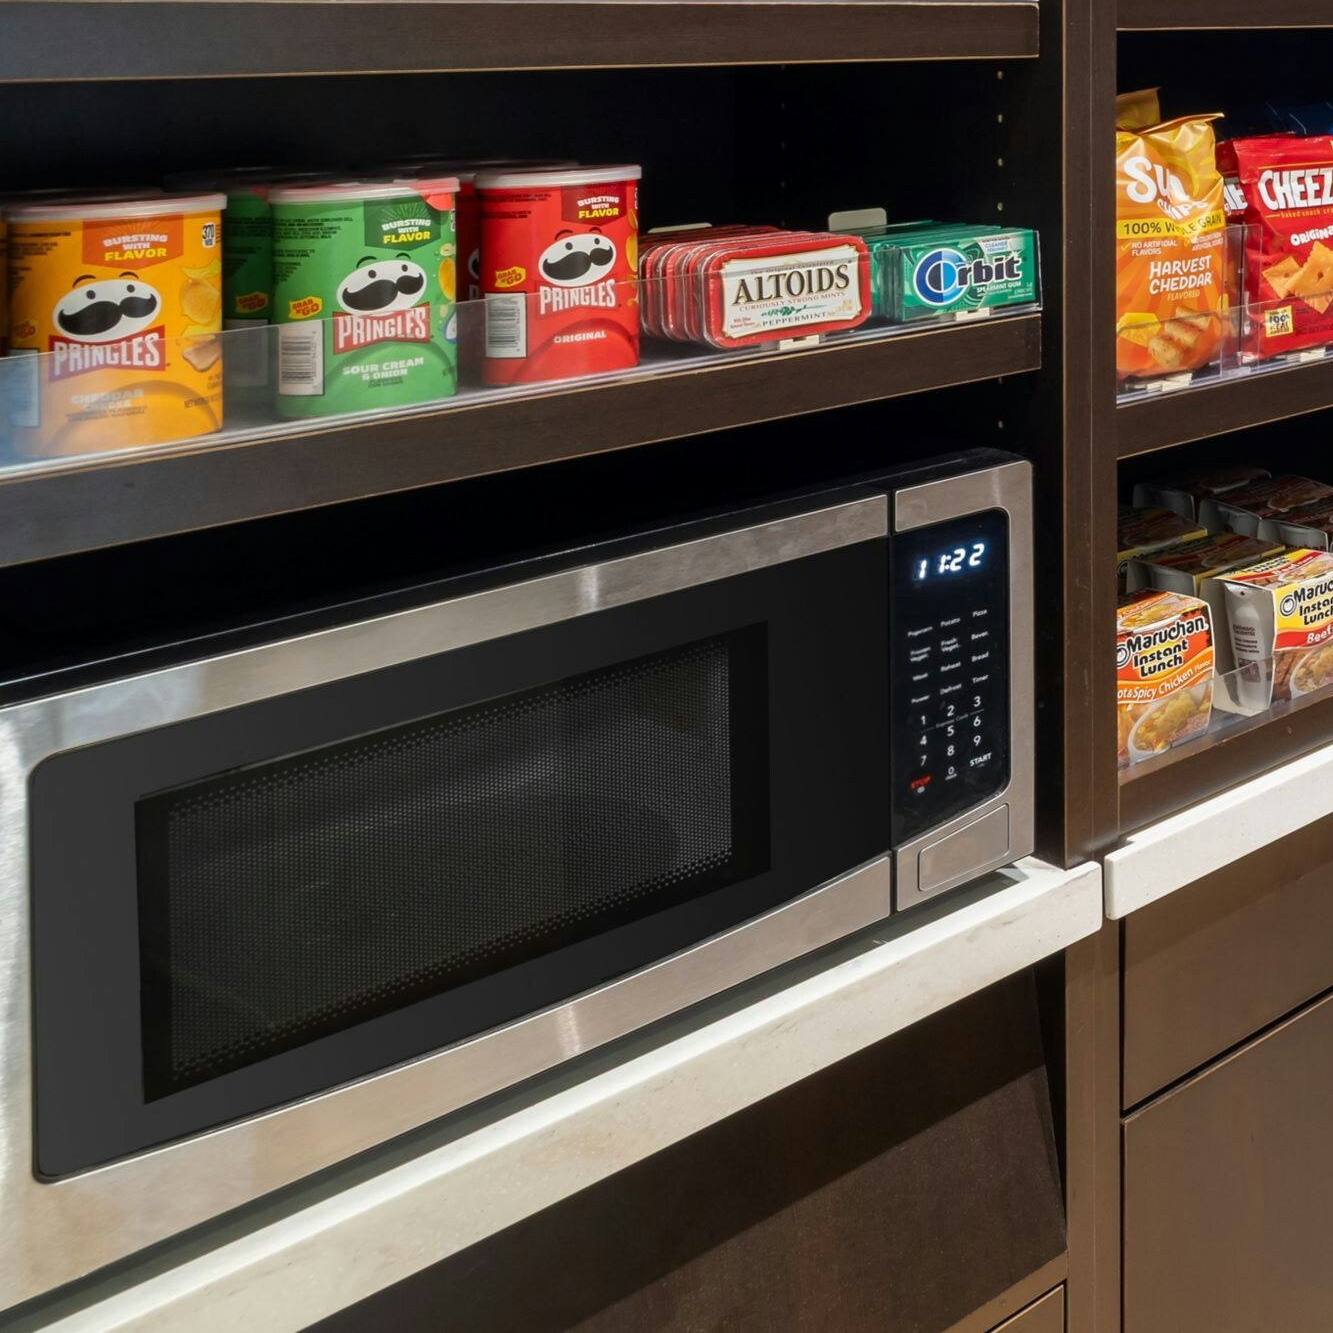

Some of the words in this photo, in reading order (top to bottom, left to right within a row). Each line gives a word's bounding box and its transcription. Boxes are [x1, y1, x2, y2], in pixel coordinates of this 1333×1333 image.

[577, 196, 619, 207] BURSTING
[578, 208, 619, 219] FLAVOR
[202, 224, 214, 240] 370
[381, 219, 431, 231] BURSTING
[1124, 221, 1161, 235] 100%
[1199, 214, 1222, 229] GRAIN
[103, 234, 168, 247] BURSTING
[383, 231, 431, 243] FLAVOR
[1143, 239, 1178, 248] ARTIFICIAL
[123, 242, 150, 251] WITH
[1132, 247, 1161, 256] FLAVORS
[104, 248, 166, 261] FLAVOR
[1149, 255, 1212, 280] HARVEST
[733, 264, 850, 305] ALTOIDS
[913, 248, 1022, 306] Orbit
[1150, 272, 1212, 295] CHEDDAR
[539, 278, 615, 315] PRINGLES
[739, 300, 785, 312] CURIOUSLY
[787, 295, 820, 306] STRONG
[821, 291, 846, 299] MINTS
[1167, 290, 1201, 301] FLAVORED
[762, 312, 827, 327] PEPPERMINT
[338, 307, 425, 348] PRINGLES
[554, 330, 607, 344] ORIGINAL
[54, 332, 160, 376] PRINGLES
[343, 362, 380, 375] SOUR
[383, 357, 424, 370] CREAM
[372, 368, 407, 380] ONION
[972, 609, 988, 617] Pizza
[1126, 616, 1206, 652] Maruchan
[1307, 626, 1331, 644] Beef
[971, 651, 989, 662] Bread
[1133, 640, 1188, 667] Instant
[1139, 654, 1183, 678] Lunch
[1158, 668, 1193, 694] Chicken
[969, 752, 992, 767] START
